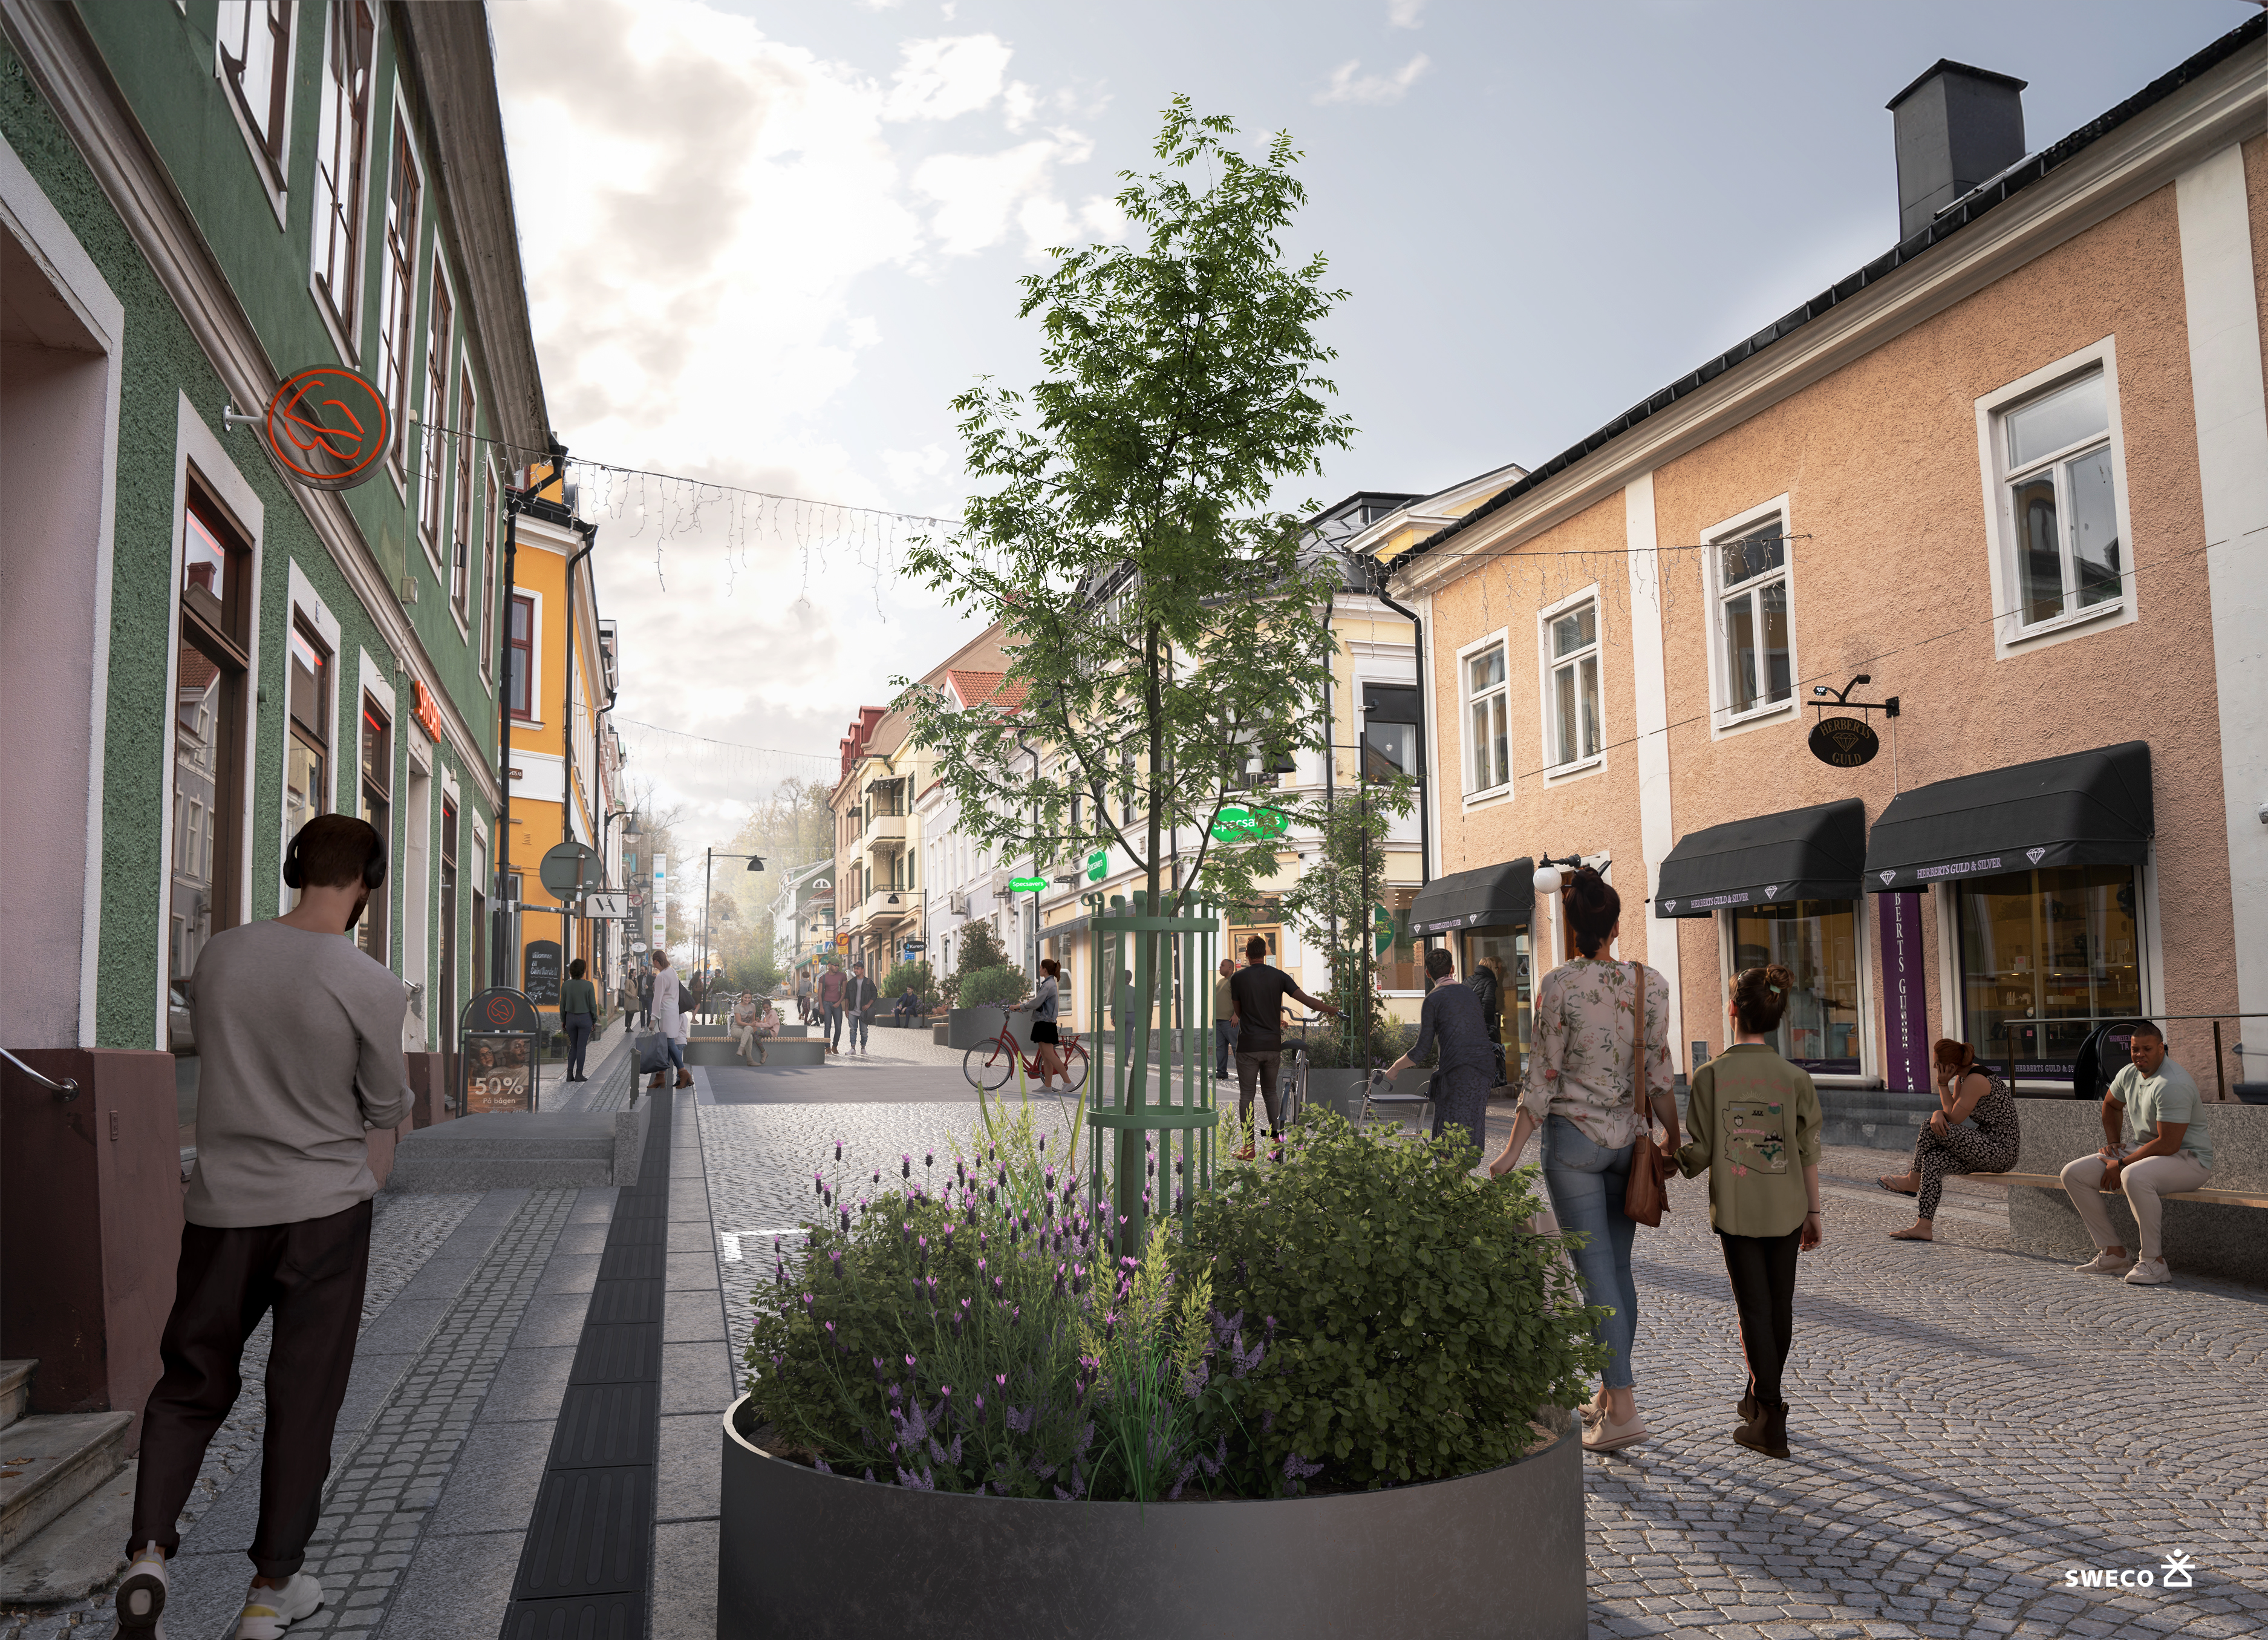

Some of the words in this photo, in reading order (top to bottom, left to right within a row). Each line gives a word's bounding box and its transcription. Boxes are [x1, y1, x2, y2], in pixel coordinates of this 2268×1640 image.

[1819, 719, 1872, 739] HERBERTS
[1831, 752, 1862, 765] GULD
[1087, 859, 1103, 874] Specsavers
[1917, 864, 1950, 879] HERBERTS
[1950, 861, 1970, 874] GULD
[1970, 861, 1976, 871] &
[1977, 857, 2002, 871] SILVER
[1690, 897, 1713, 909] HERBERTS
[1713, 895, 1727, 905] GULD
[1727, 895, 1732, 903] &
[1732, 892, 1749, 903] SILVER
[475, 1077, 524, 1095] 50%
[1750, 1079, 1766, 1088] get
